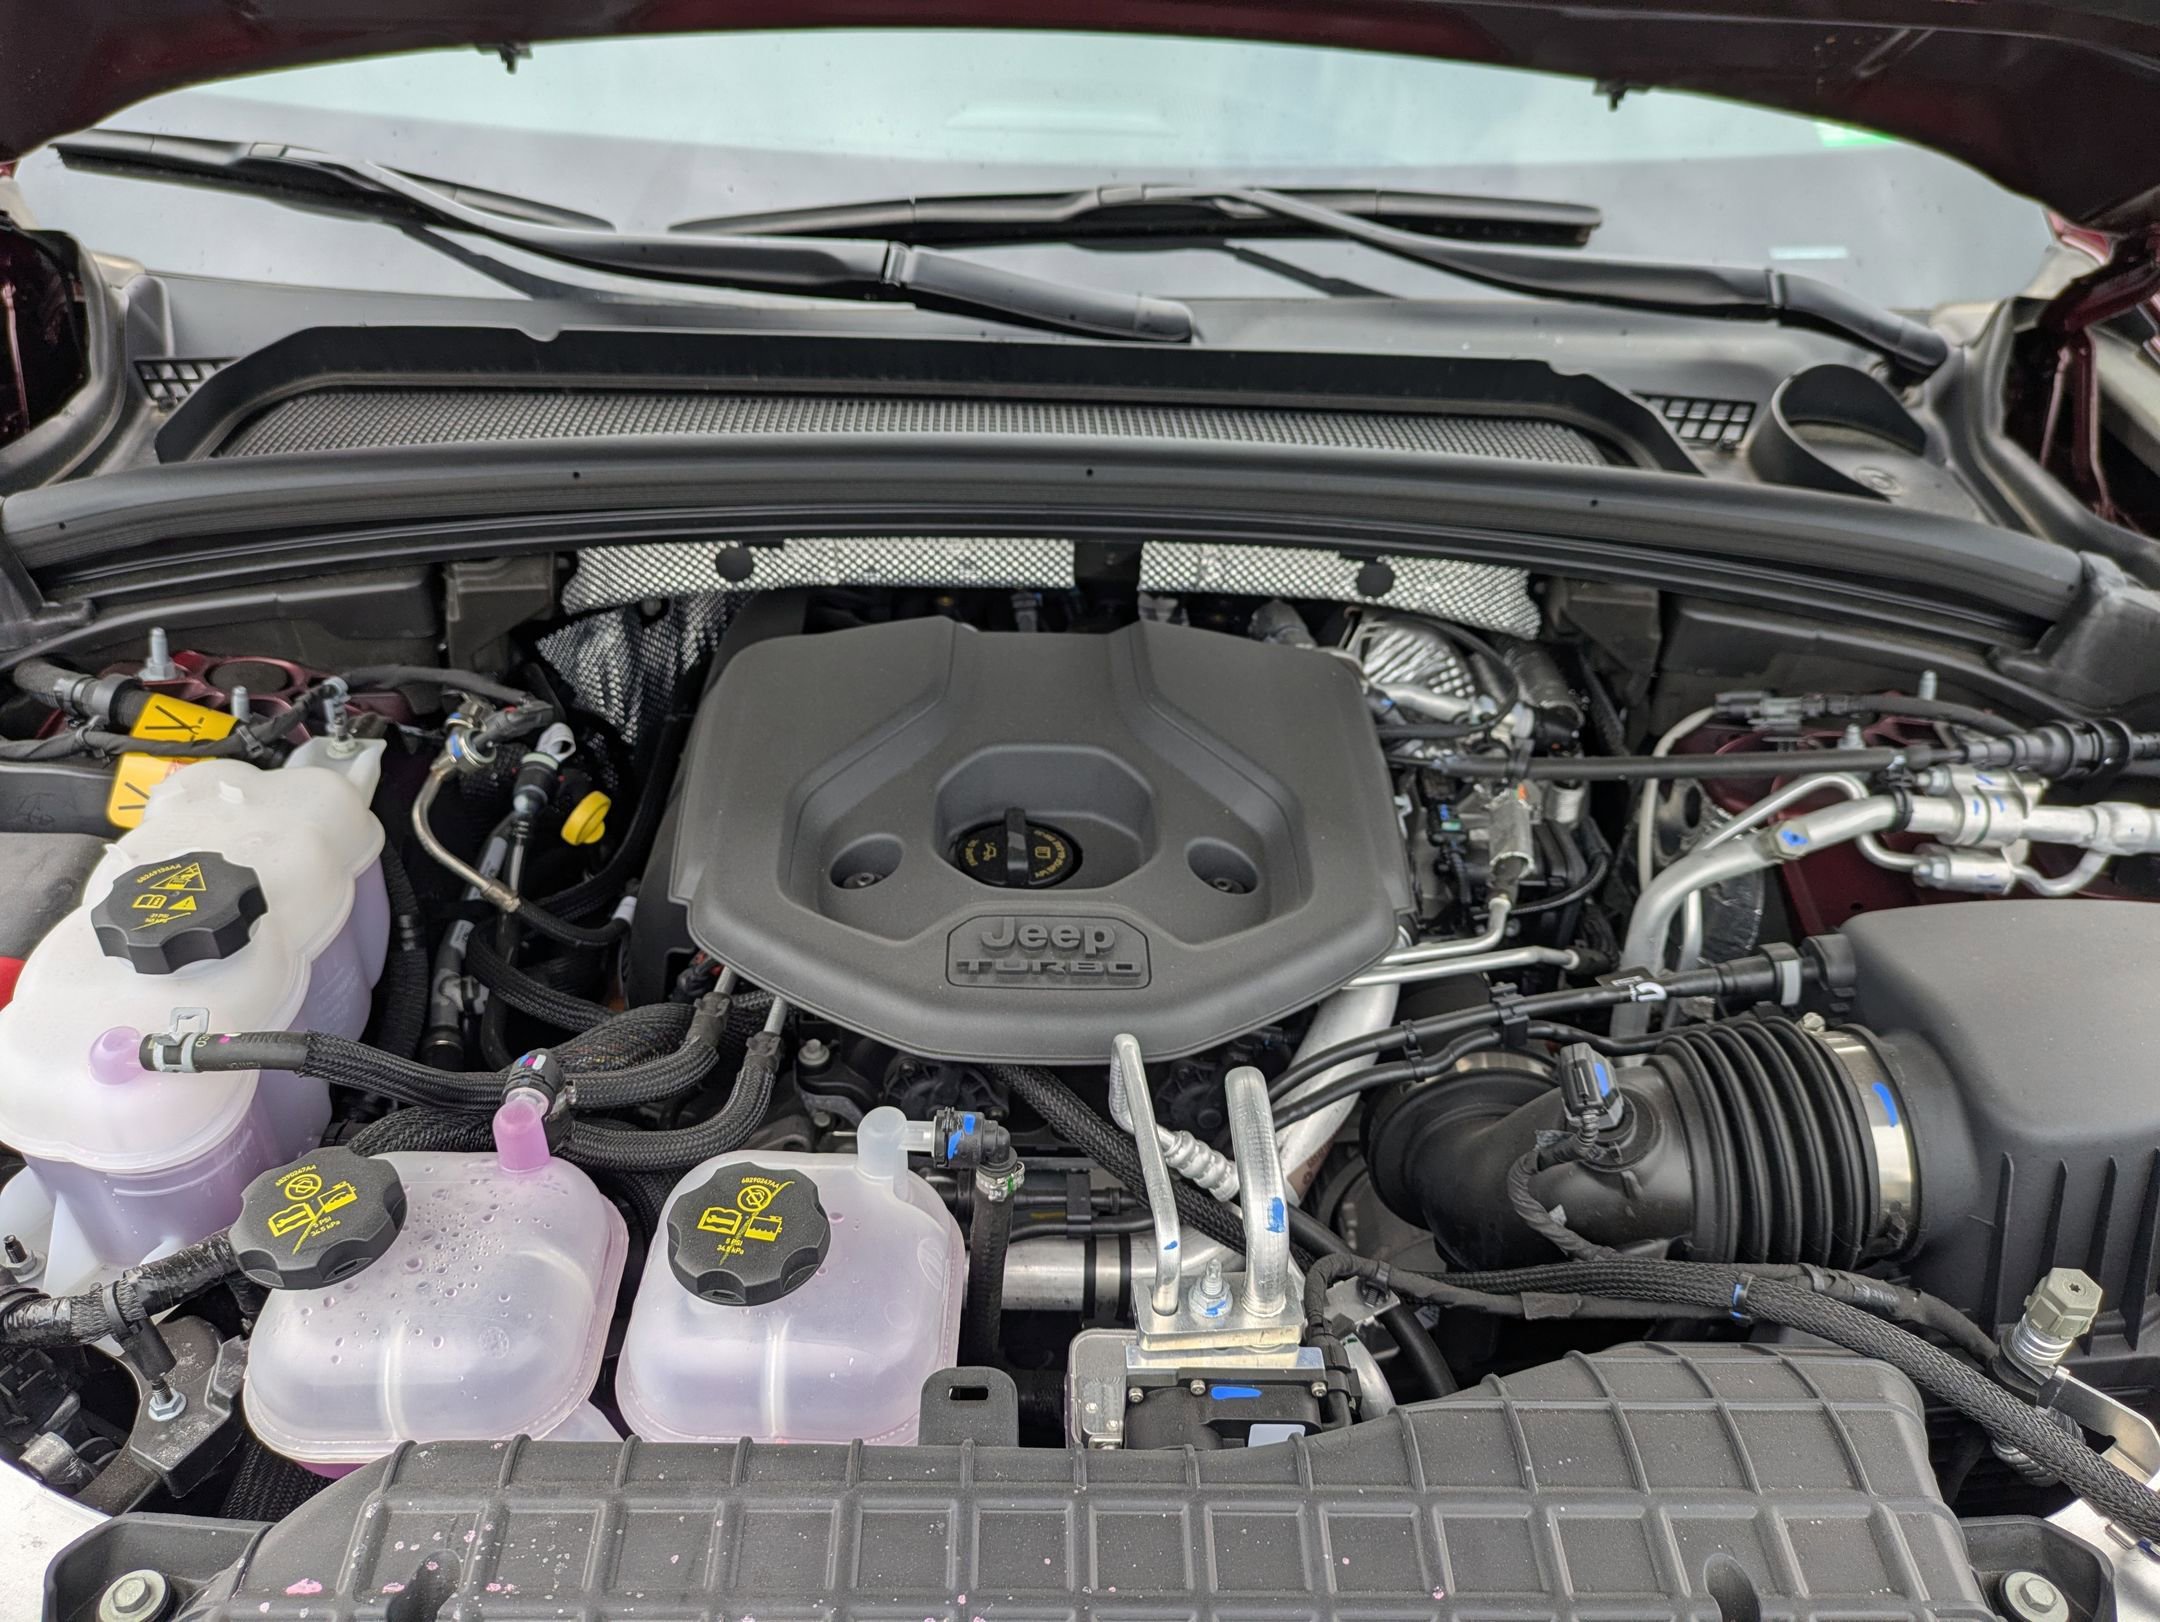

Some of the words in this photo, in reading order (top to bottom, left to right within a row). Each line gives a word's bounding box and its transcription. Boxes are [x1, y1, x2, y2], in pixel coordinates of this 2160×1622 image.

[981, 917, 1116, 958] Jeep
[956, 959, 1142, 977] TURBO
[319, 1216, 332, 1225] PSI
[731, 1238, 743, 1246] PSI
